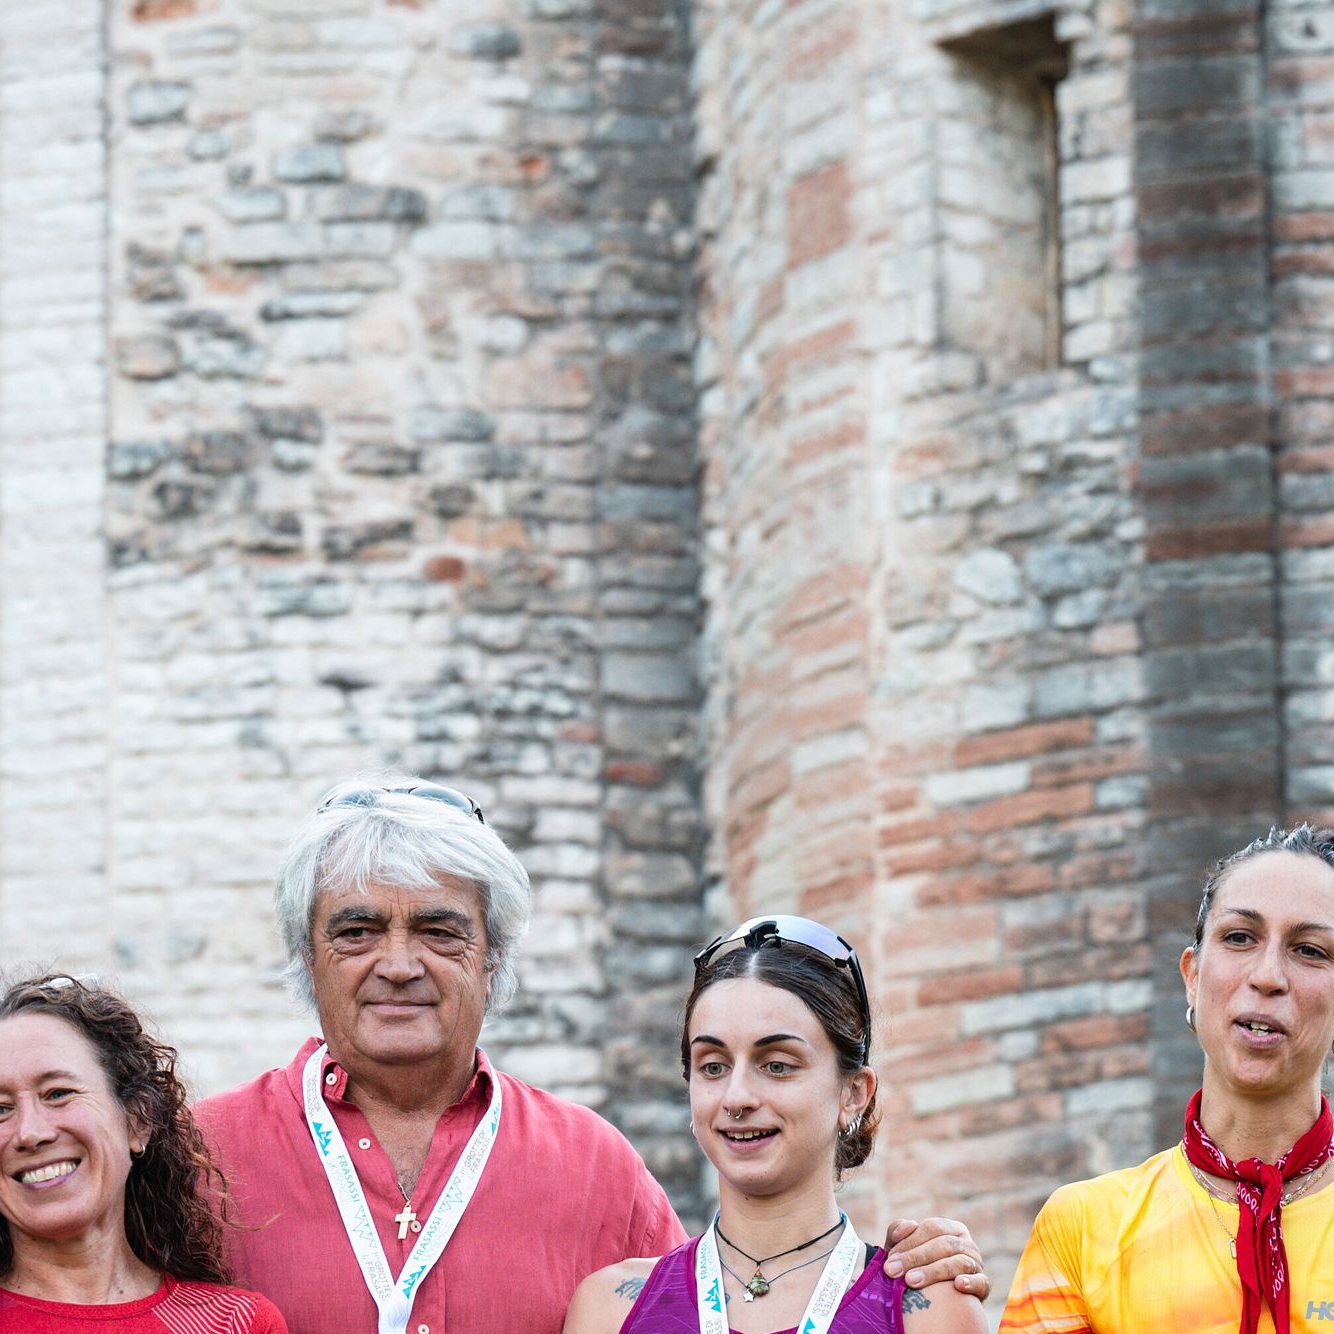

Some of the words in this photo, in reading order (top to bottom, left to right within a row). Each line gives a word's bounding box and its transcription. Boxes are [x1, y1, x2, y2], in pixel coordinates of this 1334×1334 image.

[464, 1138, 481, 1167] GROTTE
[471, 1138, 491, 1174] FRASASSI
[337, 1155, 360, 1203] FRASASSI
[413, 1217, 442, 1261] FRASASSI
[812, 1277, 833, 1313] FRASASSI
[824, 1282, 841, 1310] GROTTE
